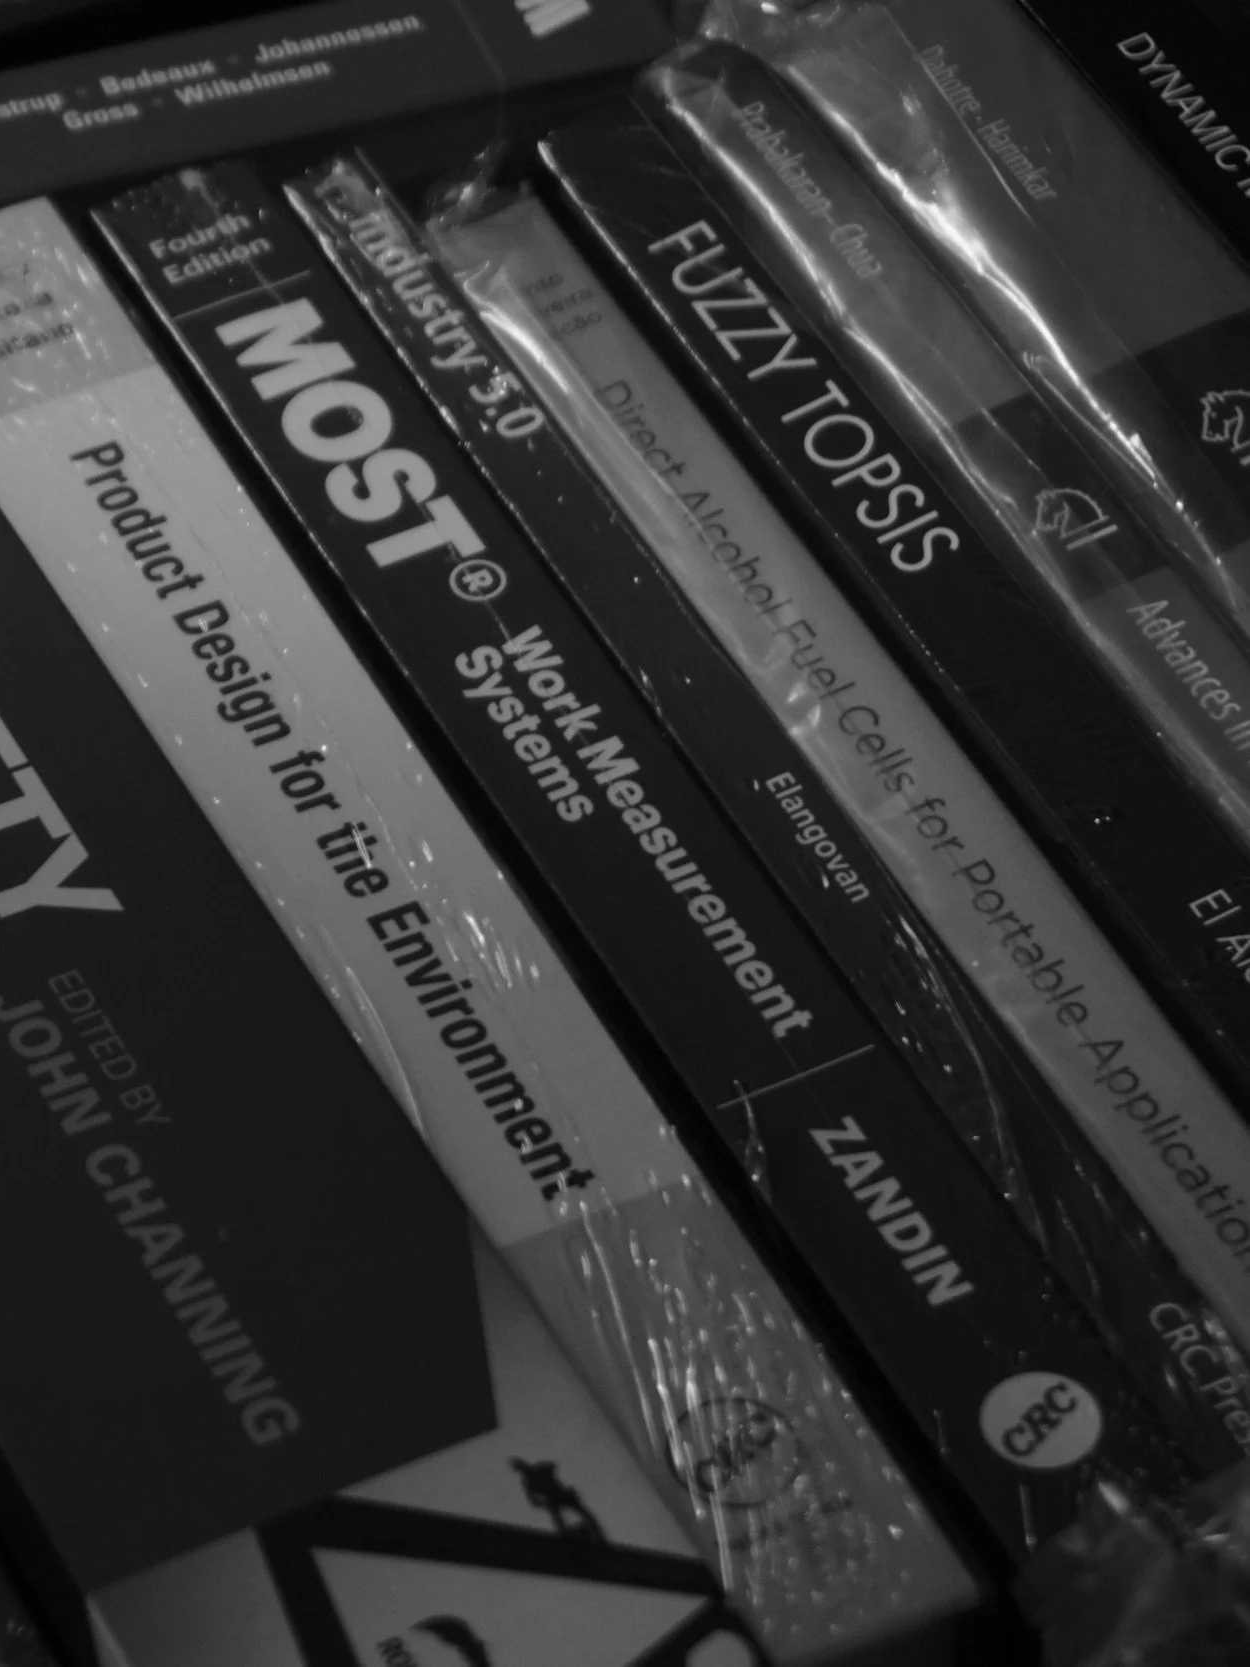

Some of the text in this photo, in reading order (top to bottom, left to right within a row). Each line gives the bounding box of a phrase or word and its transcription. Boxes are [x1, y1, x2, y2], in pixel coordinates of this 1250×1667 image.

[62, 58, 332, 133] Gross Wilhelmsen
[99, 57, 217, 98] Bedeaux
[253, 13, 422, 65] Johannessen
[1116, 31, 1250, 172] DYNAMIC
[149, 210, 252, 260] Fourth
[160, 234, 272, 287] Edition
[468, 370, 546, 439] 5.0
[648, 218, 961, 573] FUZZY TOPSIS
[454, 644, 595, 823] Systems
[596, 380, 684, 475] Direct
[682, 489, 792, 617] Alcohol
[773, 618, 857, 701] Fuel
[837, 704, 916, 795] Cells
[902, 797, 966, 869] for
[960, 856, 1091, 1030] Portable
[1126, 599, 1242, 721] Advances
[70, 441, 596, 1201] Product Design for the Environment
[502, 623, 814, 1038] Work Measurement
[765, 772, 870, 903] Elangovan
[48, 968, 173, 1127] EDITED BY
[808, 1115, 974, 1308] ZANDIN
[85, 1143, 301, 1446] CHANNING
[1000, 1381, 1078, 1459] CRC
[1148, 1302, 1250, 1460] CRC Pre
